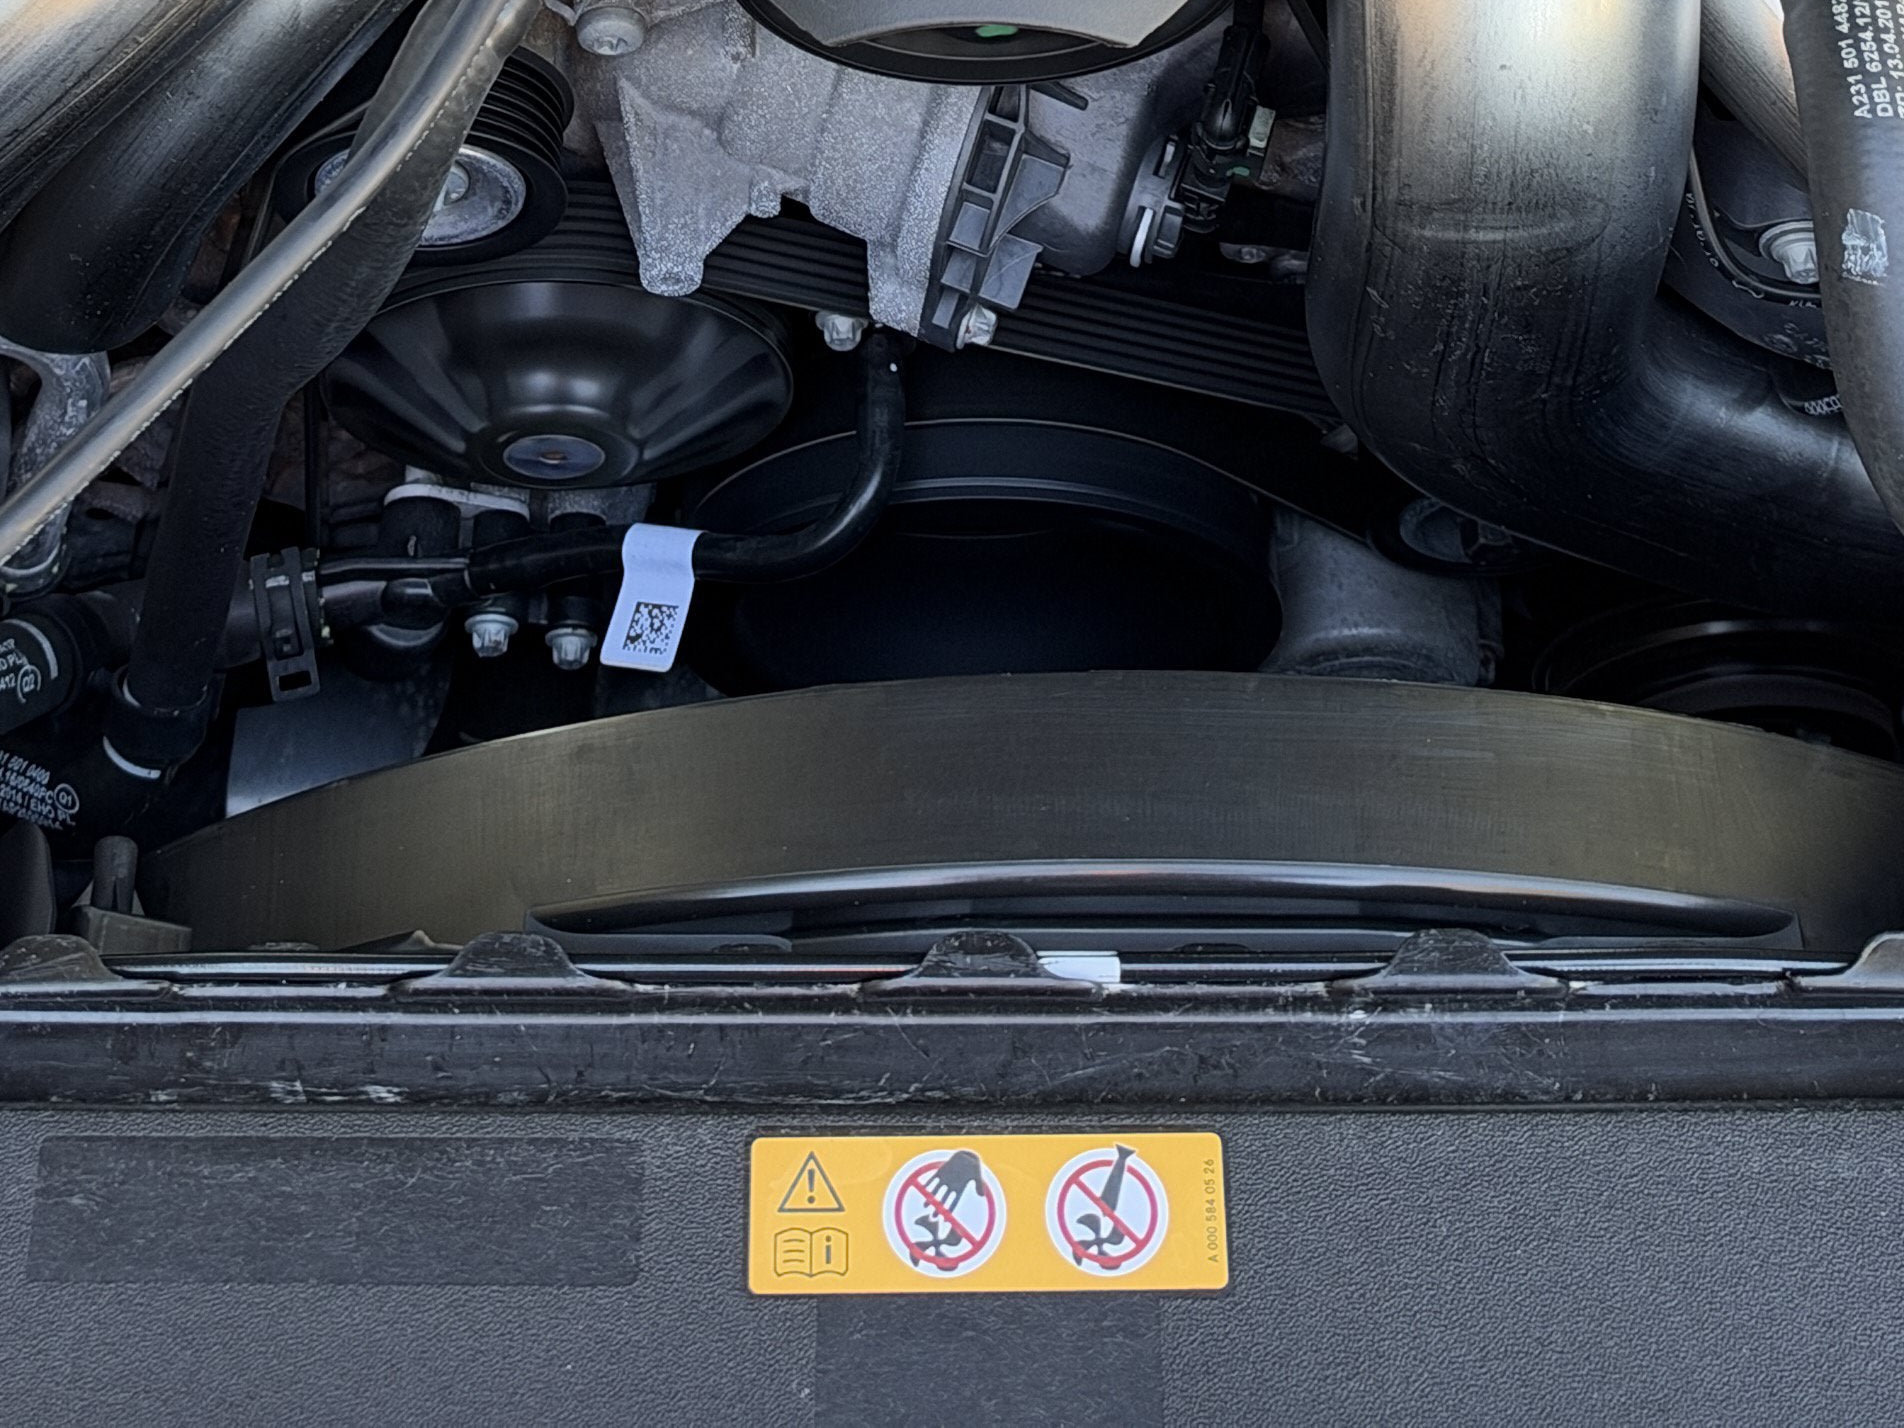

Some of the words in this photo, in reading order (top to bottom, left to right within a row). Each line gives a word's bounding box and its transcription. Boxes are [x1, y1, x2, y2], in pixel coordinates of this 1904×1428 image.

[1837, 38, 1859, 69] 501
[1846, 73, 1872, 120] A231
[1868, 75, 1893, 118] DBL
[1203, 1158, 1214, 1173] 26
[1204, 1178, 1215, 1194] 05
[1205, 1198, 1216, 1221] 584
[1206, 1226, 1217, 1250] 000
